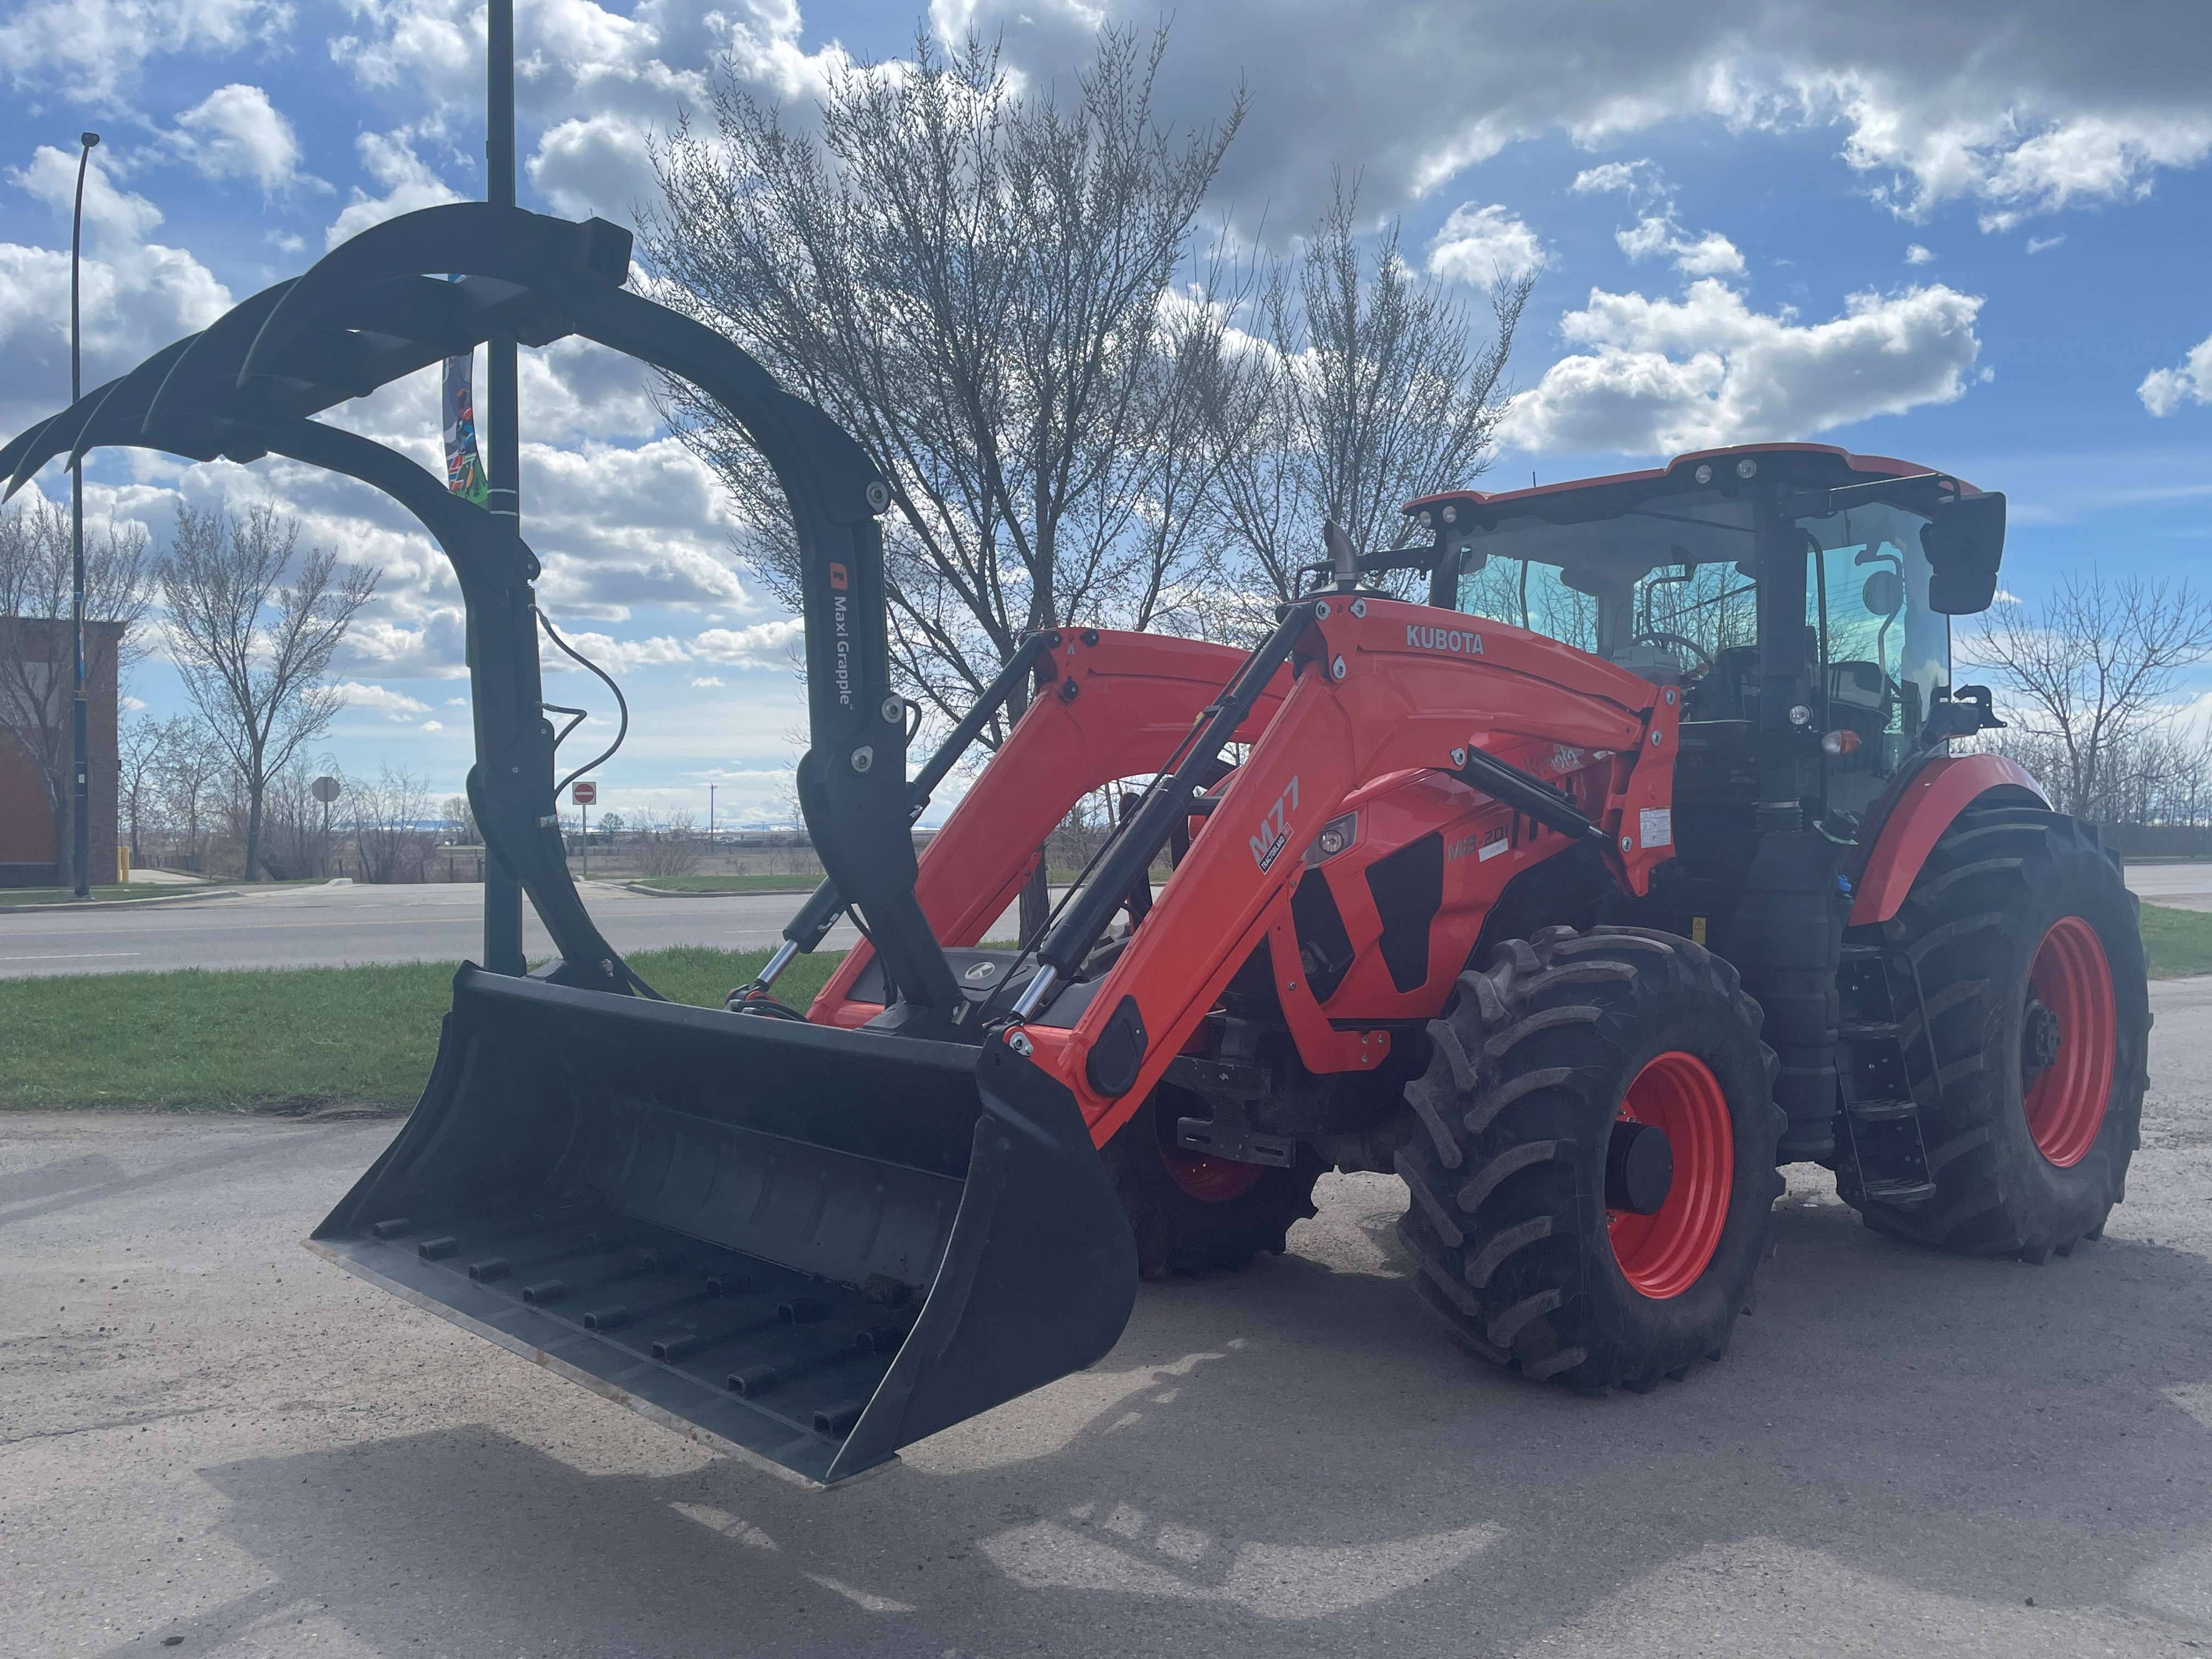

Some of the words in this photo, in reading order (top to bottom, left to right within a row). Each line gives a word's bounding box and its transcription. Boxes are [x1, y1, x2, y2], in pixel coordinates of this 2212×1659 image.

[834, 596, 848, 636] Maxi
[1407, 624, 1484, 654] KUBOTA
[1249, 775, 1299, 864] M77
[1261, 836, 1285, 870] TRACTORLAND
